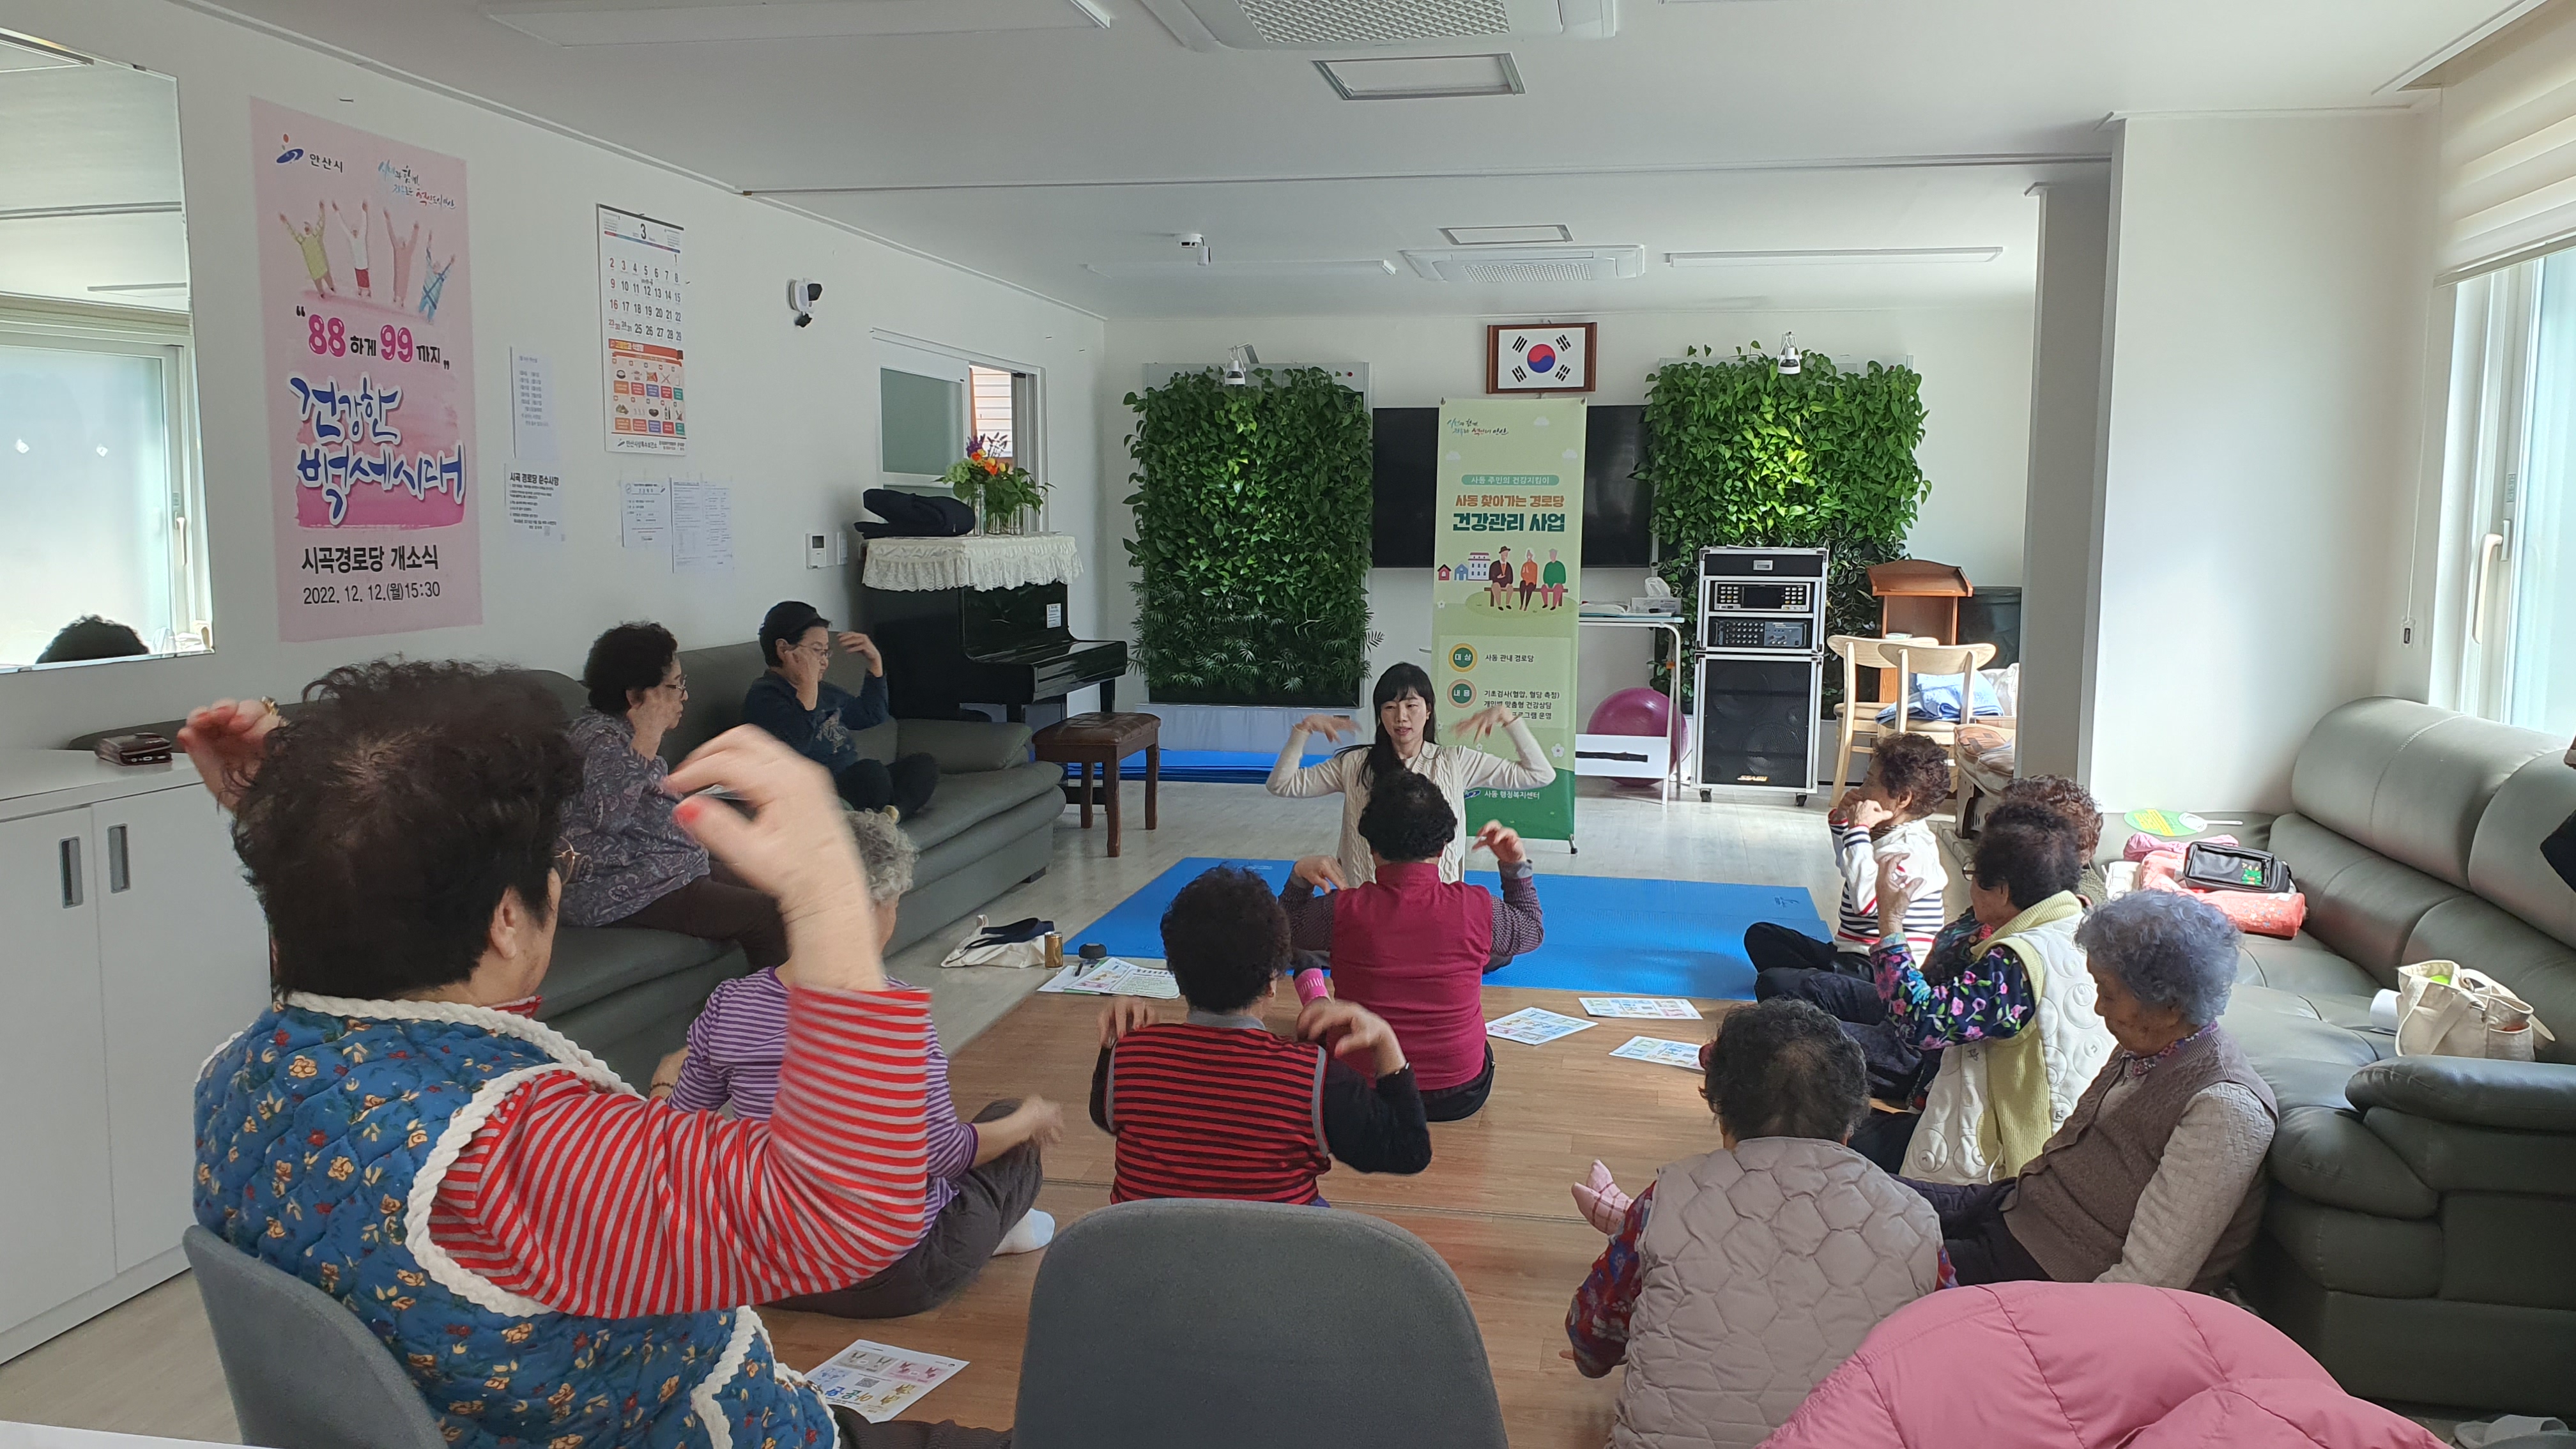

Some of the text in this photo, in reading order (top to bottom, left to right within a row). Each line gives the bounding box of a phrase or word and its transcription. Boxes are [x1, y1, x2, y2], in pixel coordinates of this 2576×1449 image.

[309, 153, 343, 173] 안산시
[640, 223, 647, 240] 3
[674, 254, 677, 263] 1
[610, 257, 678, 282] 2 3 4 5 6 7 8
[610, 278, 615, 288] 9
[621, 280, 629, 291] 10
[633, 283, 640, 293] 11
[643, 286, 651, 296] 12
[654, 288, 661, 298] 13
[665, 290, 671, 300] 14
[675, 293, 681, 303] 15
[610, 298, 681, 322] 16 17 18 19 20 21 22
[634, 323, 642, 334] 25
[645, 325, 653, 336] 26
[657, 327, 664, 337] 27
[289, 376, 400, 439] 건강한
[296, 444, 464, 520] 백세시대
[522, 473, 537, 484] 경로당
[539, 475, 559, 486] 준수사항
[1488, 476, 1510, 484] 주민의
[1512, 476, 1549, 484] 건강지킴이
[1455, 494, 1565, 507] 사동 찾아가는 경로당
[1453, 513, 1565, 532] 건강관리 사업
[301, 544, 440, 574] 시곡경로당 개소식
[303, 586, 341, 605] 2022.
[344, 585, 363, 602] 12.
[1529, 691, 1542, 699] 혈당
[1505, 701, 1524, 709] 맞춤형
[1539, 712, 1552, 720] 운영
[1500, 790, 1540, 800] 행정복지센터
